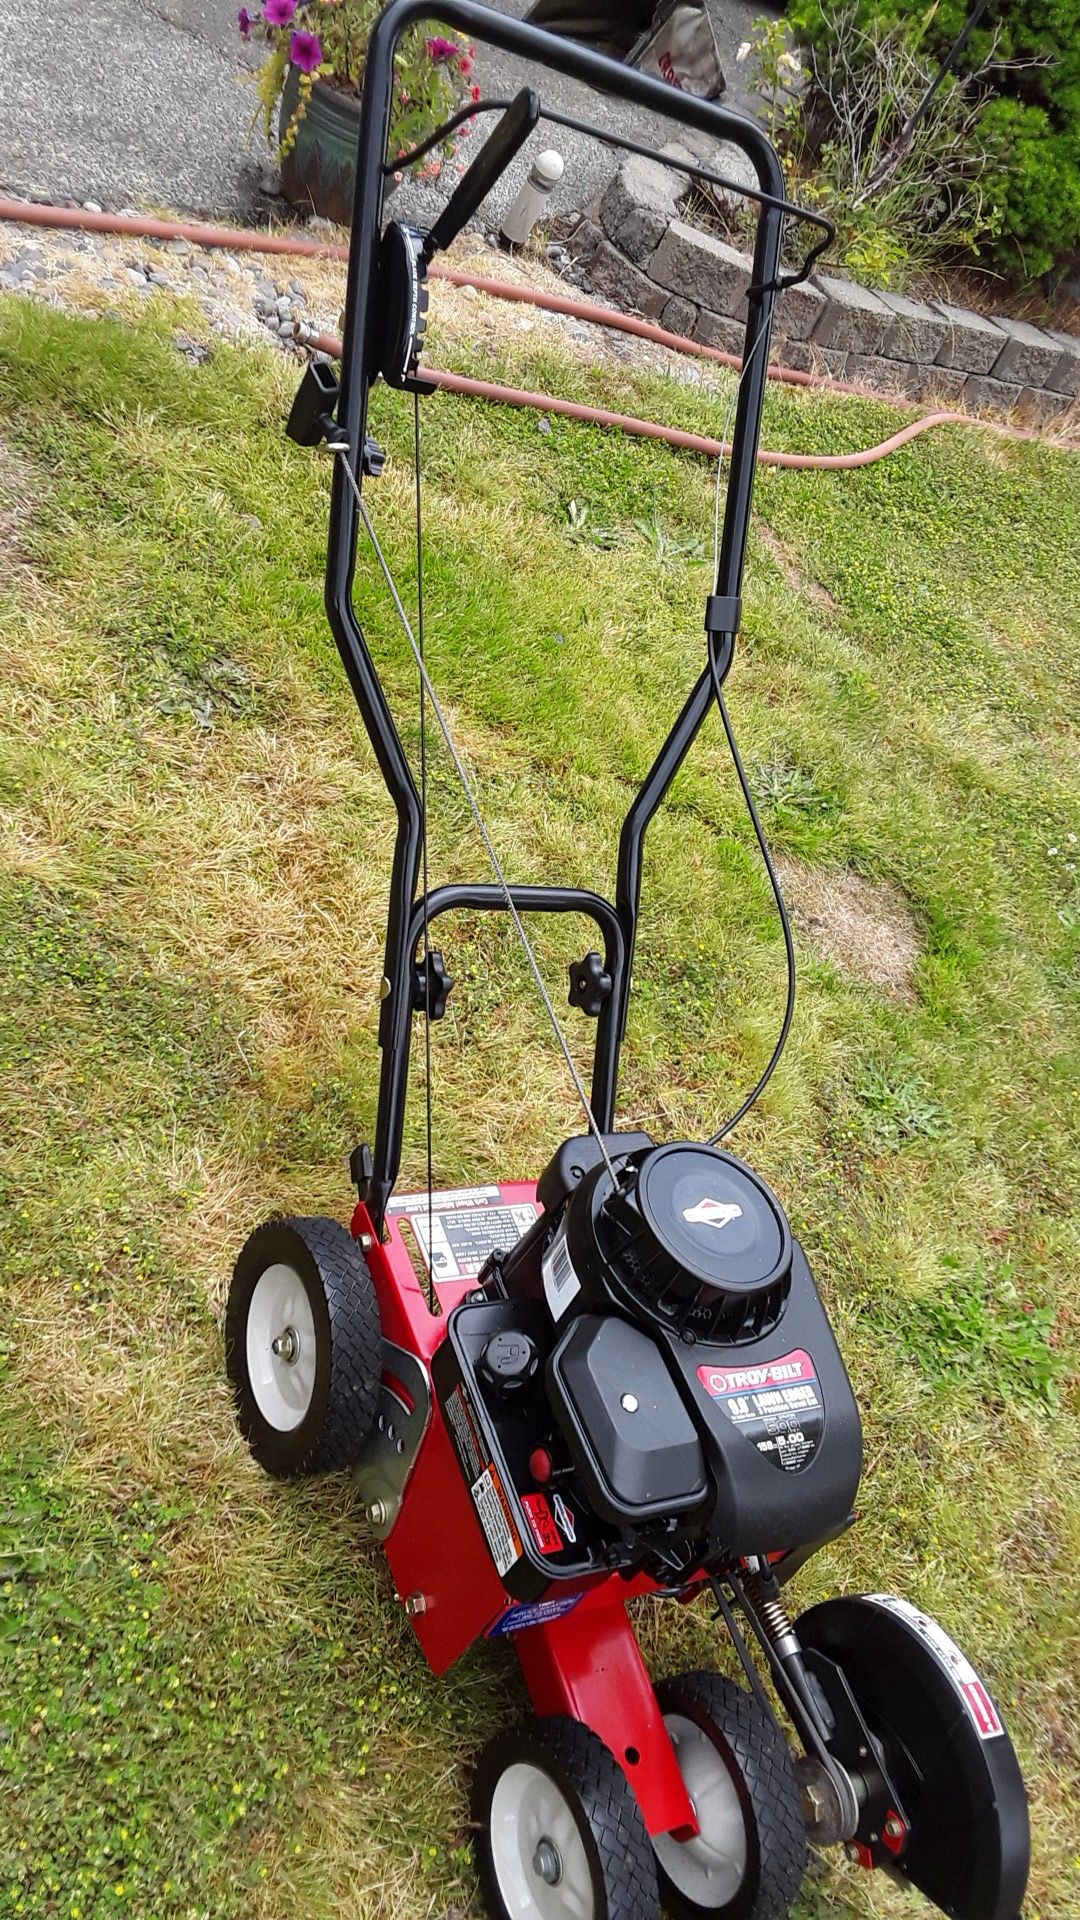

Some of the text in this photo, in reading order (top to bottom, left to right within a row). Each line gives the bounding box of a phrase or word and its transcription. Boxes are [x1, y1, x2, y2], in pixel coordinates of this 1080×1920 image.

[410, 303, 418, 336] CONTROL
[455, 1199, 473, 1208] Wheel
[724, 1362, 804, 1389] TROY-BILT
[752, 1391, 784, 1408] LAWN
[781, 1385, 816, 1402] EDGER
[496, 1487, 518, 1542] WARNING
[523, 1500, 534, 1518] PUSH
[531, 1519, 537, 1528] TO
